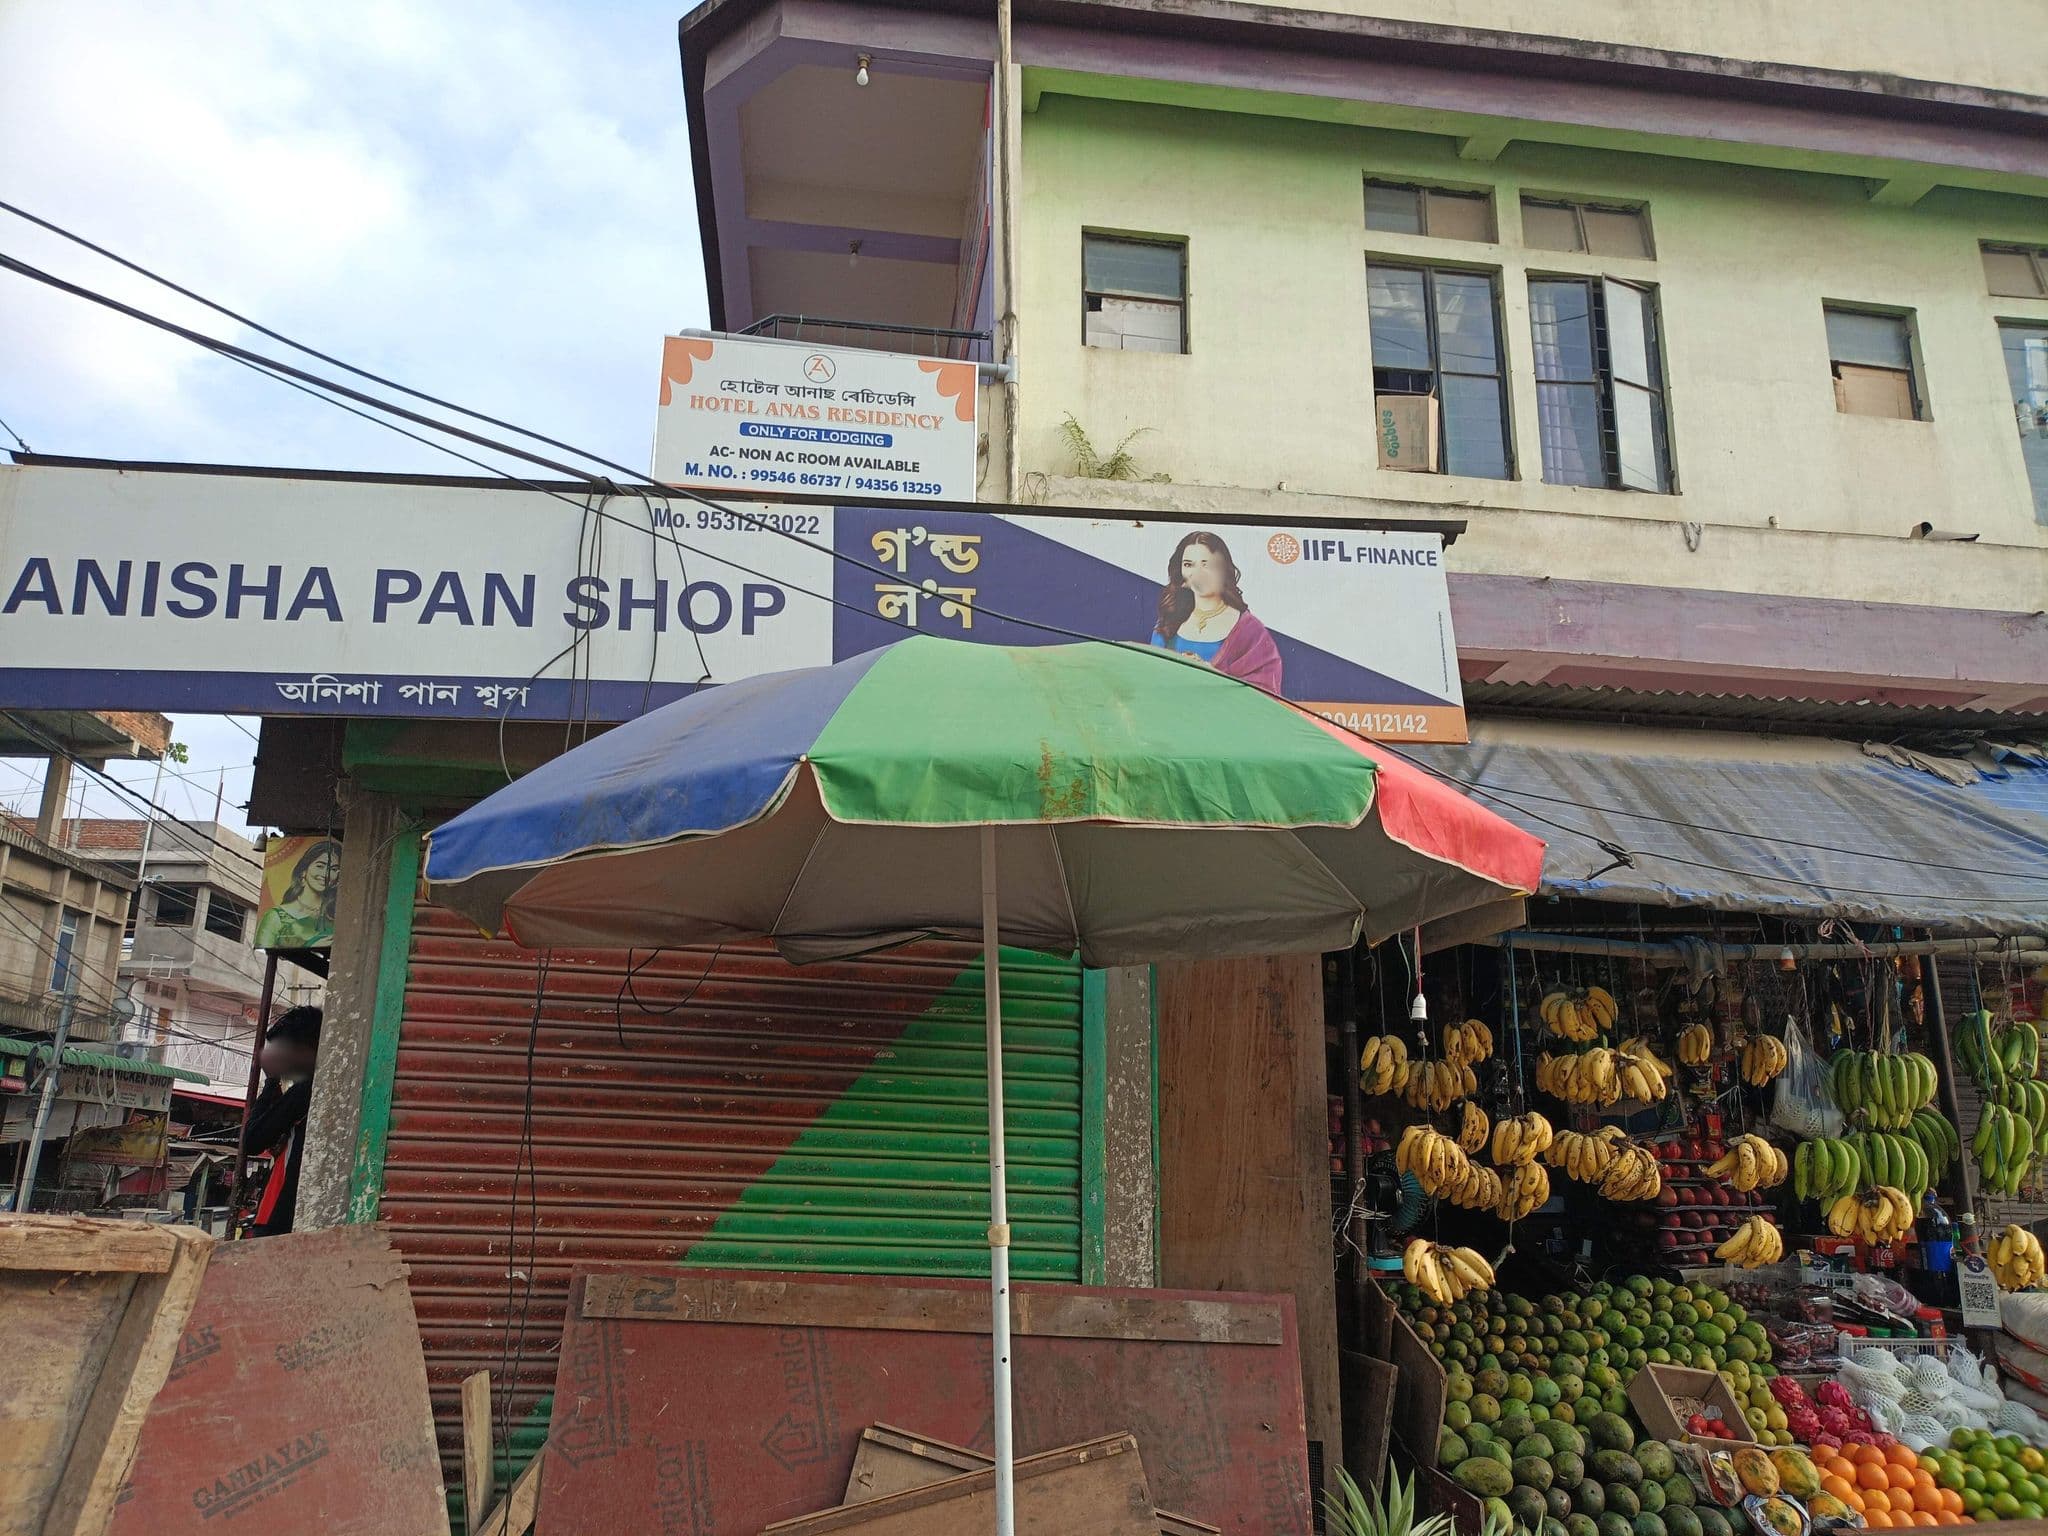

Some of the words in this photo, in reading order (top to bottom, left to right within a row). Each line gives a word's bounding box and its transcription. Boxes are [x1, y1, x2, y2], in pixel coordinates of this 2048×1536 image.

[720, 378, 780, 396] হোটেল
[784, 385, 836, 401] আনাছ
[690, 395, 759, 414] HOTEL
[765, 402, 820, 419] ANAS
[827, 407, 944, 430] RESIDENCY
[748, 424, 787, 438] ONLY
[789, 428, 818, 441] FOR
[821, 431, 885, 446] LODGING
[709, 445, 735, 458] AC-
[739, 447, 772, 461] NON
[775, 450, 795, 463] AC
[798, 452, 841, 467] ROOM
[843, 456, 920, 473] AVAILABLE
[685, 462, 703, 476] M.
[708, 463, 738, 480] NO.
[750, 469, 796, 484] 99546
[799, 472, 842, 487] 86737
[855, 477, 899, 492] 94356
[902, 481, 942, 495] 13259
[654, 508, 691, 528] Mo.
[697, 510, 820, 535] 9531273022
[1302, 539, 1351, 563] IIFL
[1356, 547, 1437, 567] FINANCE
[1, 557, 344, 623] ANISHA
[372, 568, 536, 628] PAN
[562, 575, 787, 636] SHOP
[275, 674, 383, 704] অনিশা
[398, 681, 462, 706] পান
[107, 1069, 147, 1085] CHICKEN
